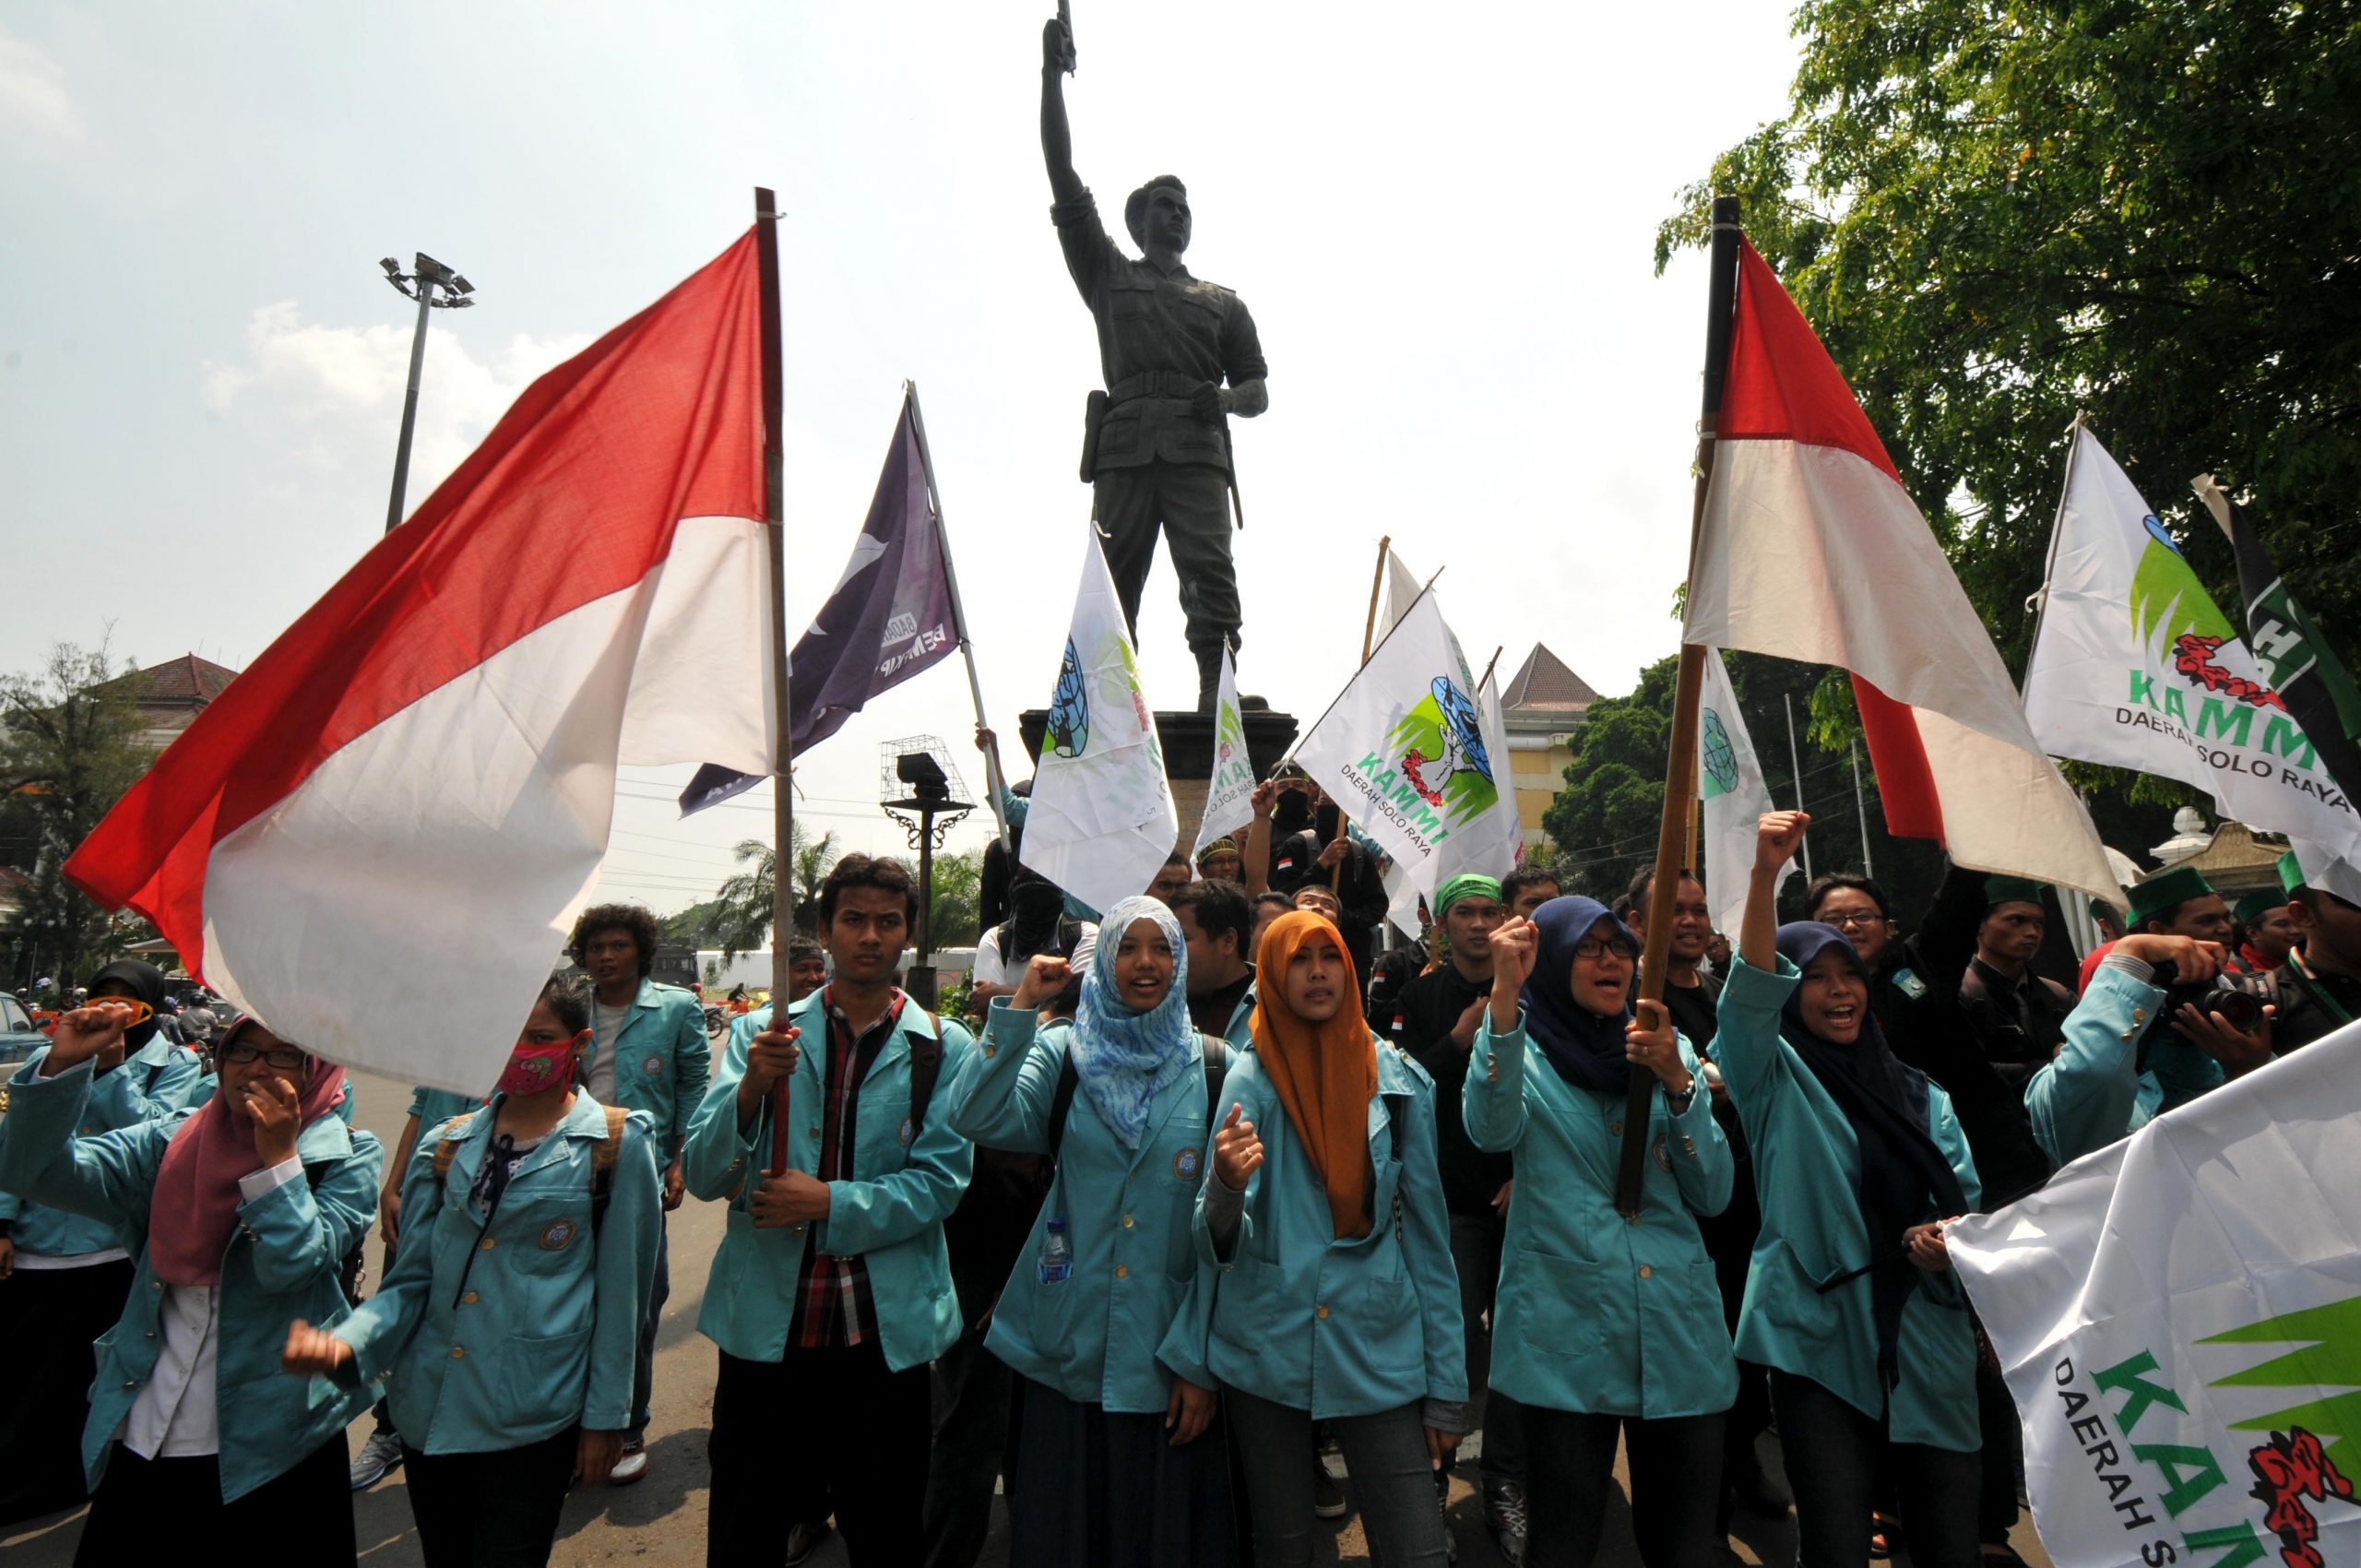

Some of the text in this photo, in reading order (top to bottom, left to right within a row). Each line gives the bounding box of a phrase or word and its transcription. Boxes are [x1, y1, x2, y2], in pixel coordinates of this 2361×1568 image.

[2128, 669, 2336, 784] KAMM
[1341, 764, 1431, 858] DAERAH SOLO RAYA
[1356, 751, 1449, 846] KAMMI
[2197, 744, 2273, 778] SOLO
[2281, 768, 2351, 814] RAYA
[2055, 1357, 2156, 1531] DAERAH
